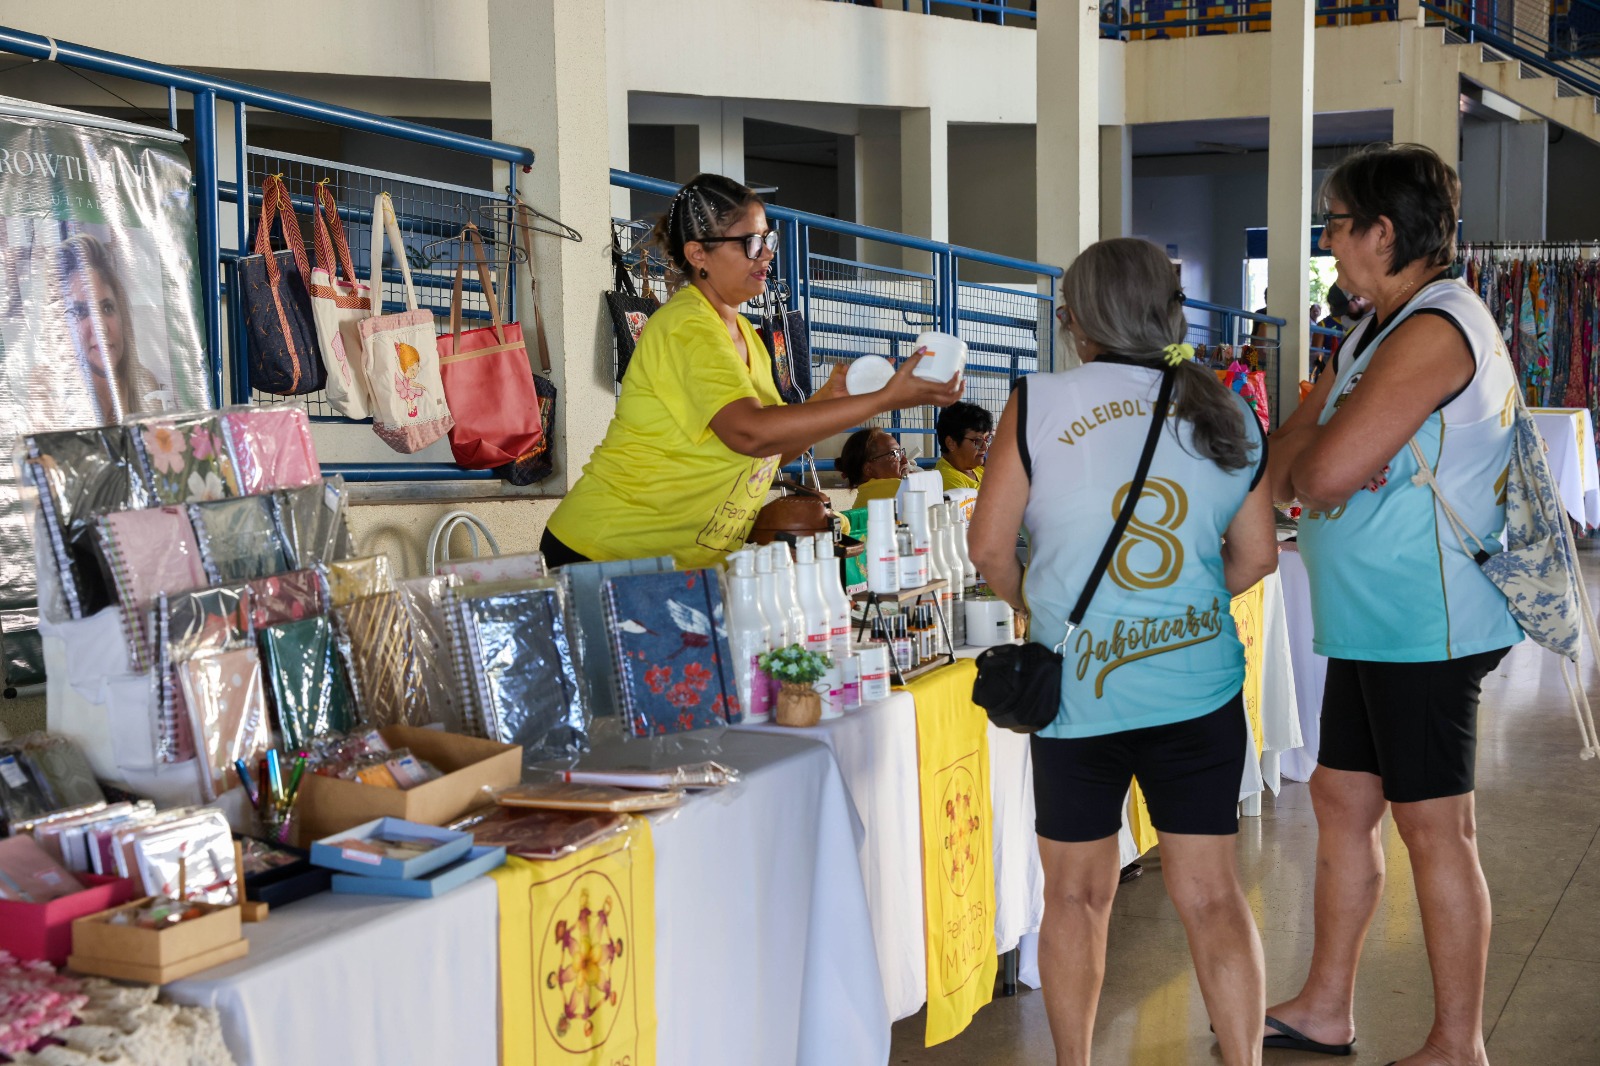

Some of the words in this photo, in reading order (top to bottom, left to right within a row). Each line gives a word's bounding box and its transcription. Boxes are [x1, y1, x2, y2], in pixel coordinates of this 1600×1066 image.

[15, 190, 127, 213] RESULTADS
[1057, 399, 1147, 446] VOLEIBOL
[1106, 476, 1189, 592] 8
[1075, 596, 1222, 692] Jaboticabal
